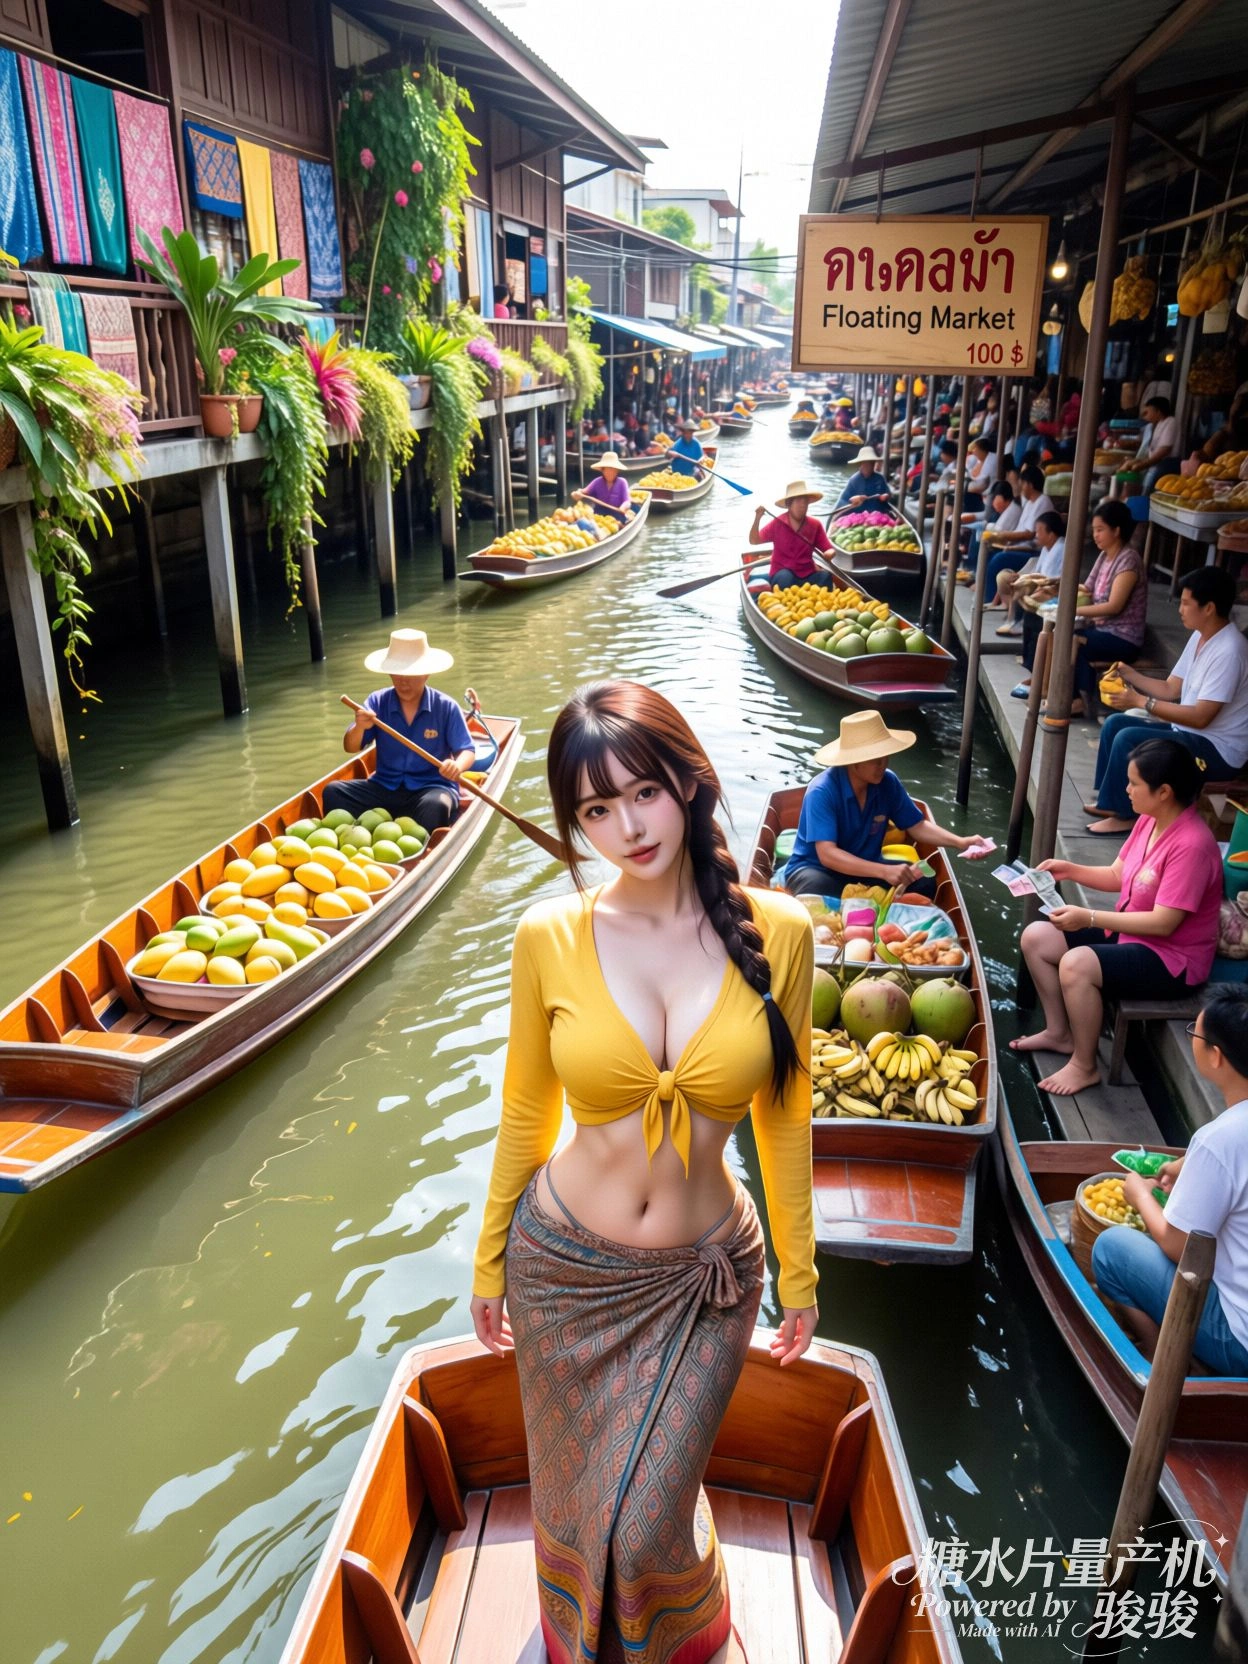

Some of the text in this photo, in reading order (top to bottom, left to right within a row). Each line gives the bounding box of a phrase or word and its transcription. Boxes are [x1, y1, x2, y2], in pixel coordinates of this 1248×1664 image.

[823, 304, 1015, 335] Floating Market
[966, 340, 1023, 367] 100 $
